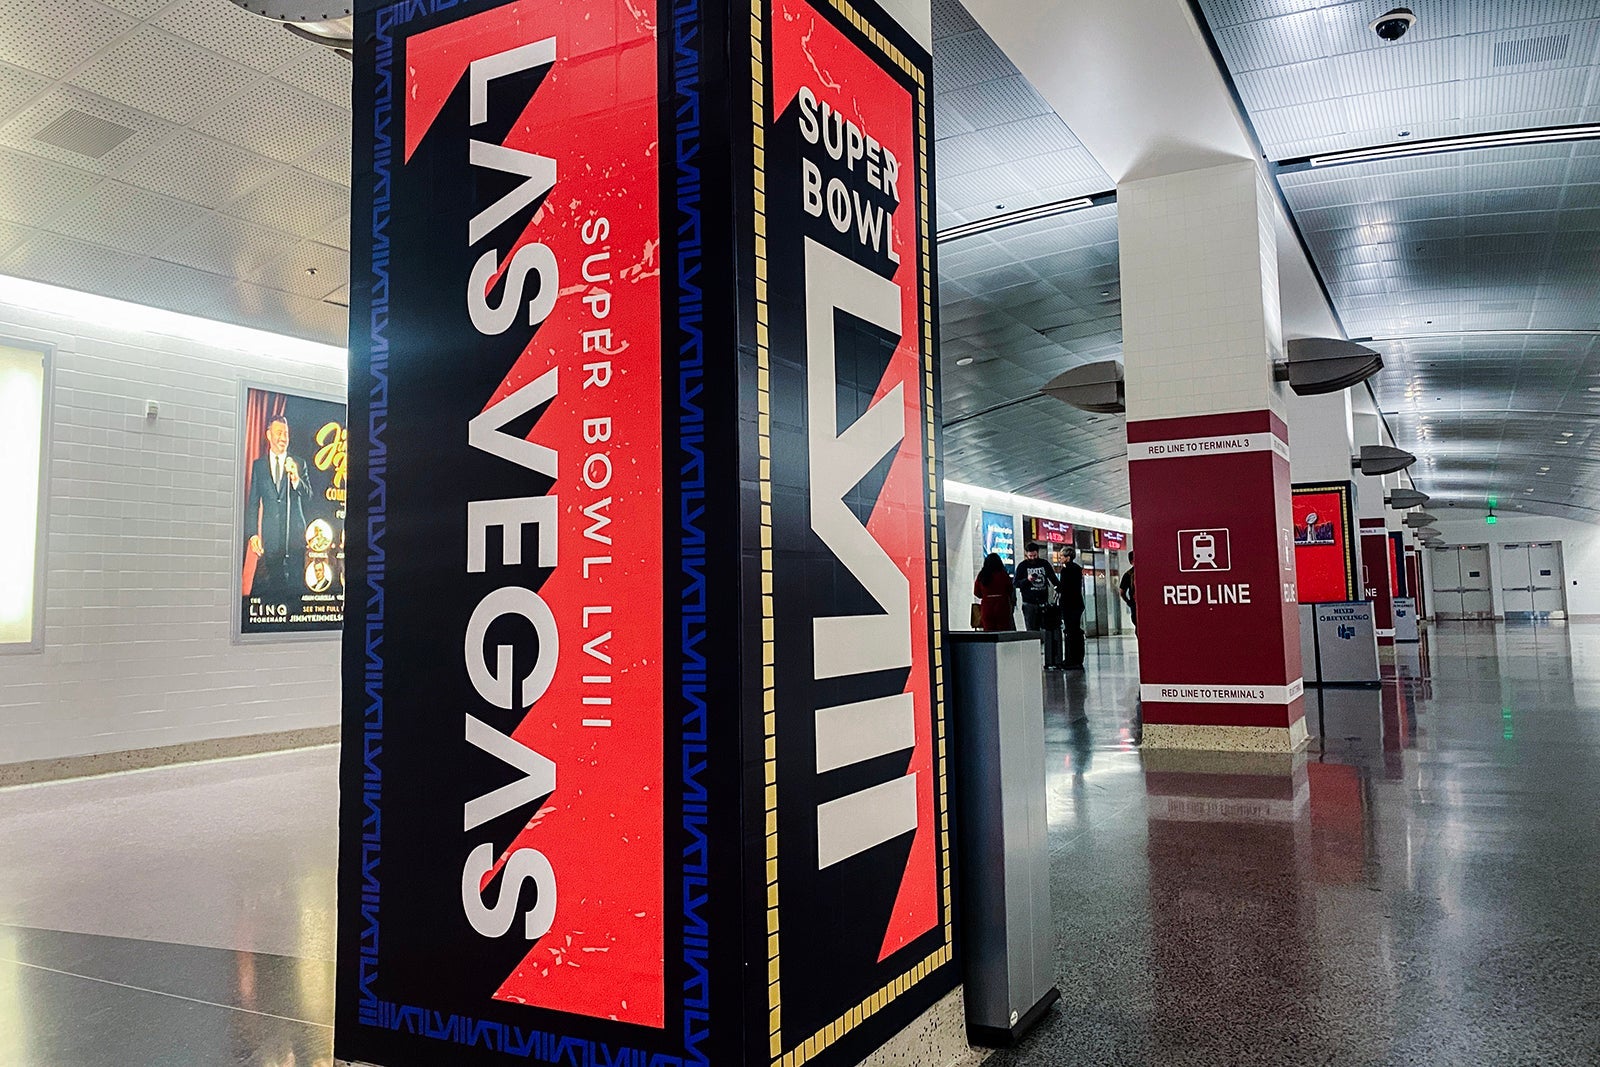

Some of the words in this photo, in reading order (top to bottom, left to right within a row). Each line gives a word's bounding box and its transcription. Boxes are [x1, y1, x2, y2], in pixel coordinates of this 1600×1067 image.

[467, 36, 560, 336] LAS
[799, 86, 900, 203] SUPER
[802, 156, 900, 265] BOWL
[581, 216, 611, 390] SUPER
[582, 416, 613, 579] BOWL
[1148, 445, 1165, 454] RED
[1167, 443, 1185, 453] LINE
[1186, 442, 1198, 451] TO
[1199, 440, 1243, 450] TERMINAL
[1244, 438, 1250, 447] 3
[249, 604, 287, 616] LINQ
[1163, 585, 1202, 605] RED
[1206, 583, 1251, 604] LINE
[462, 367, 560, 940] VEGAS
[582, 605, 613, 728] LVIII
[1161, 688, 1179, 698] RED
[1180, 689, 1199, 698] LINE
[1200, 689, 1211, 698] TO
[1213, 689, 1257, 699] TERMINAL
[1259, 690, 1265, 699] 3
